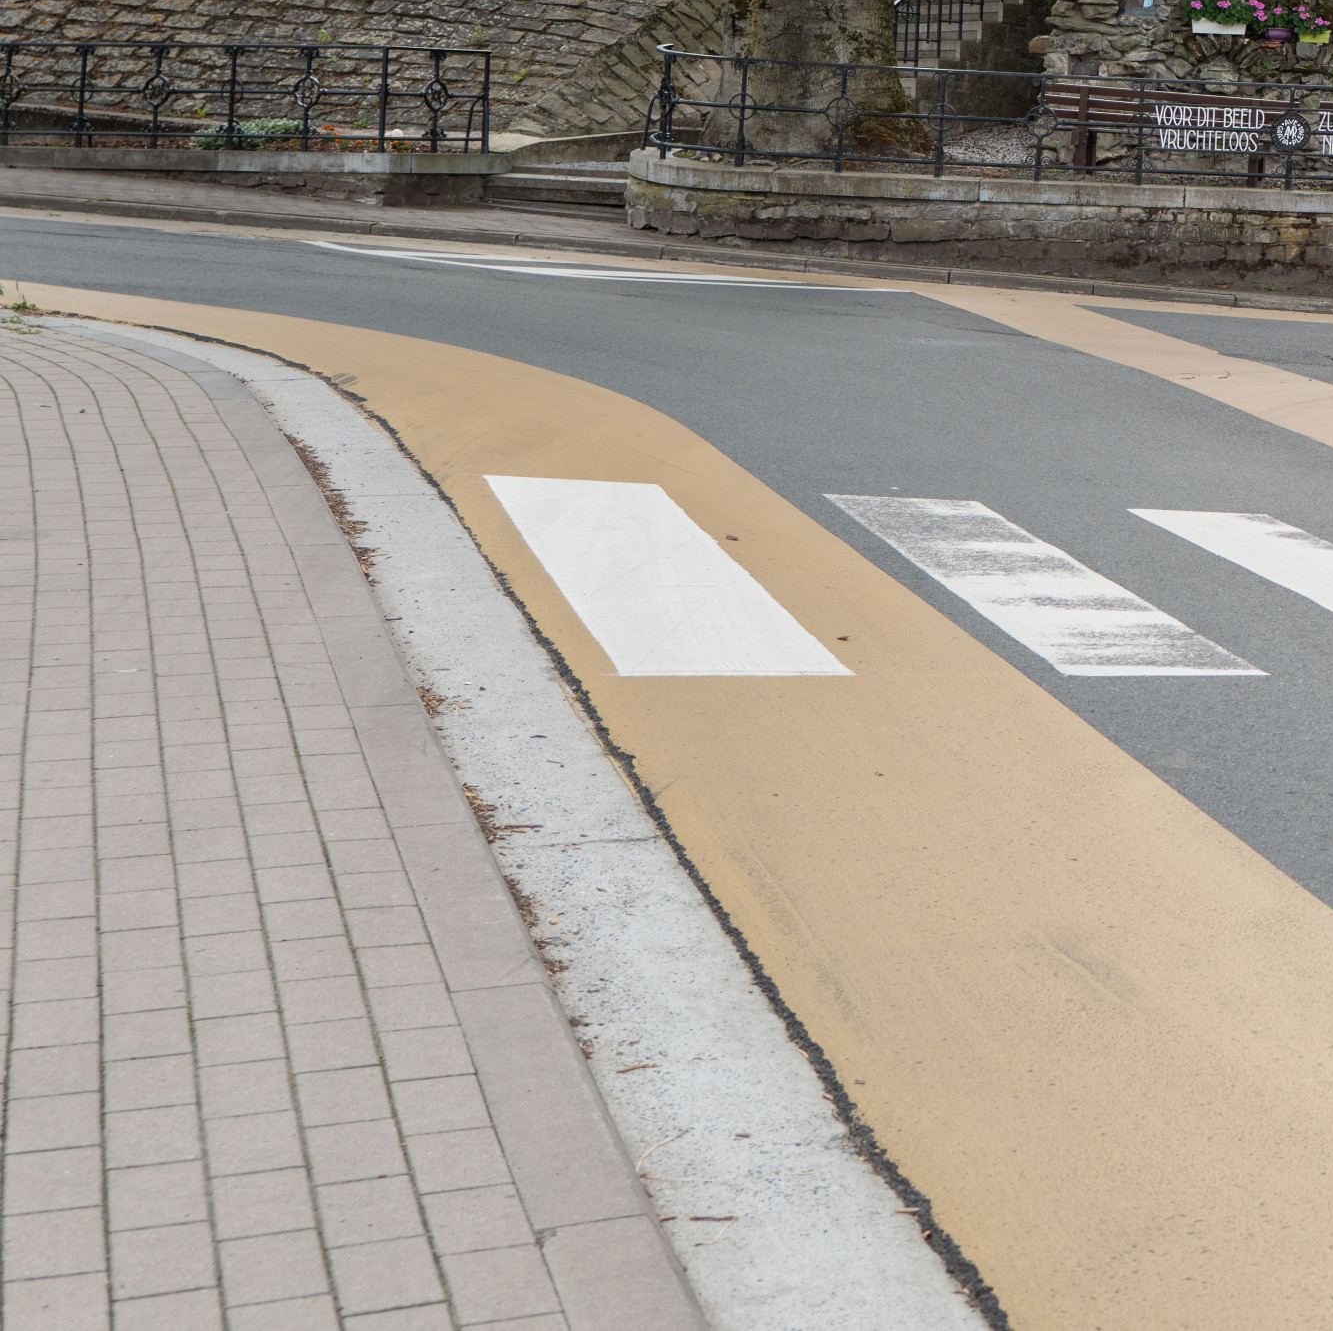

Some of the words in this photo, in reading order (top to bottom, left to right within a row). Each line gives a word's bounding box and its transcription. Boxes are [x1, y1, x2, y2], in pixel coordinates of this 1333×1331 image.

[1155, 105, 1192, 127] VOOR
[1197, 107, 1216, 128] DIT
[1223, 108, 1265, 129] BEELD
[1160, 129, 1259, 151] VRUCHTELOOS
